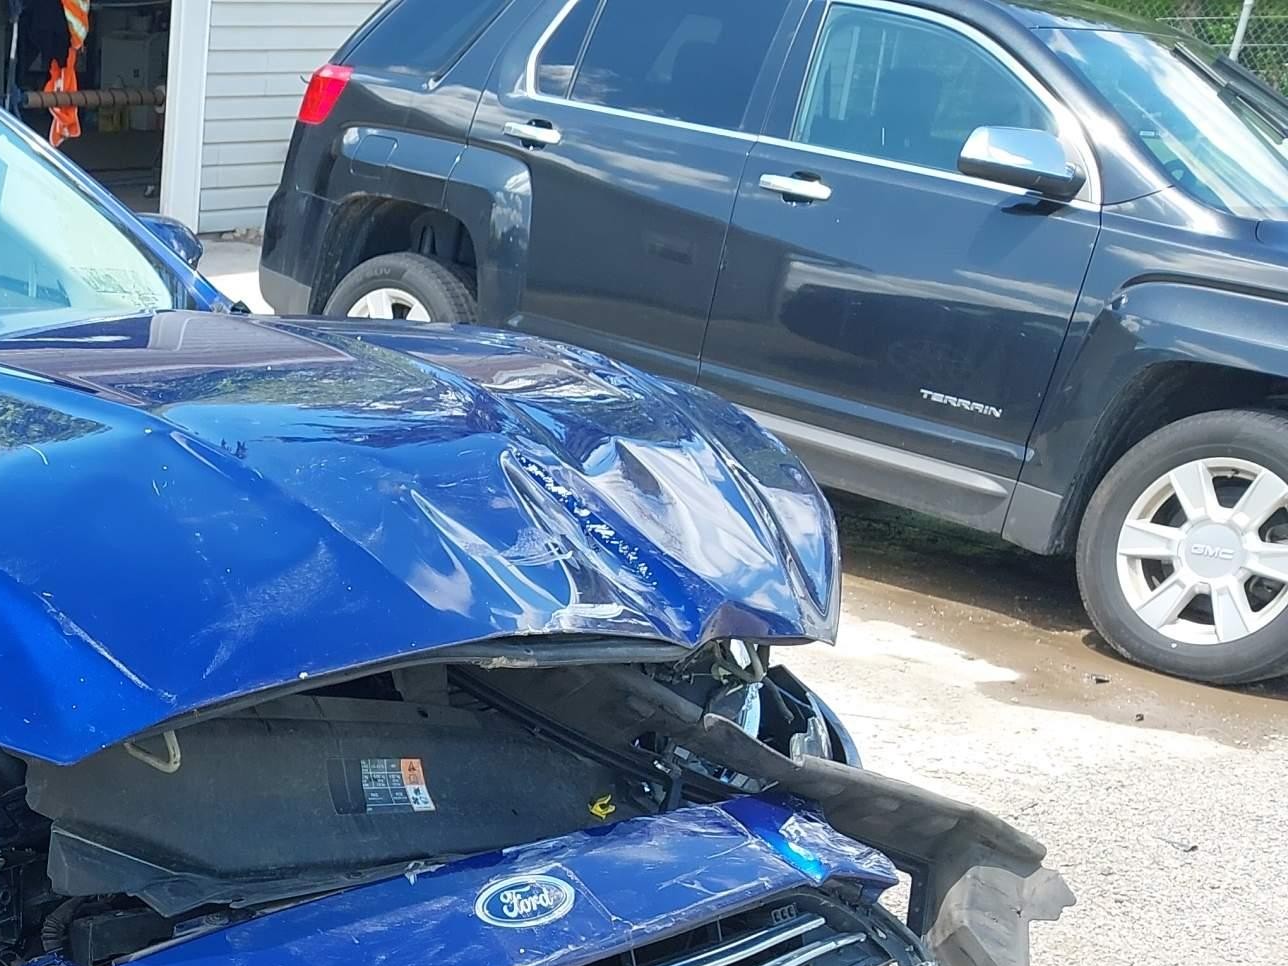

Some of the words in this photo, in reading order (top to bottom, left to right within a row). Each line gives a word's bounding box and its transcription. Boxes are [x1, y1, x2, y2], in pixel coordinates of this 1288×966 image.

[920, 388, 1003, 418] TERRAIN
[1191, 543, 1235, 560] GMC
[500, 885, 554, 918] Ford
